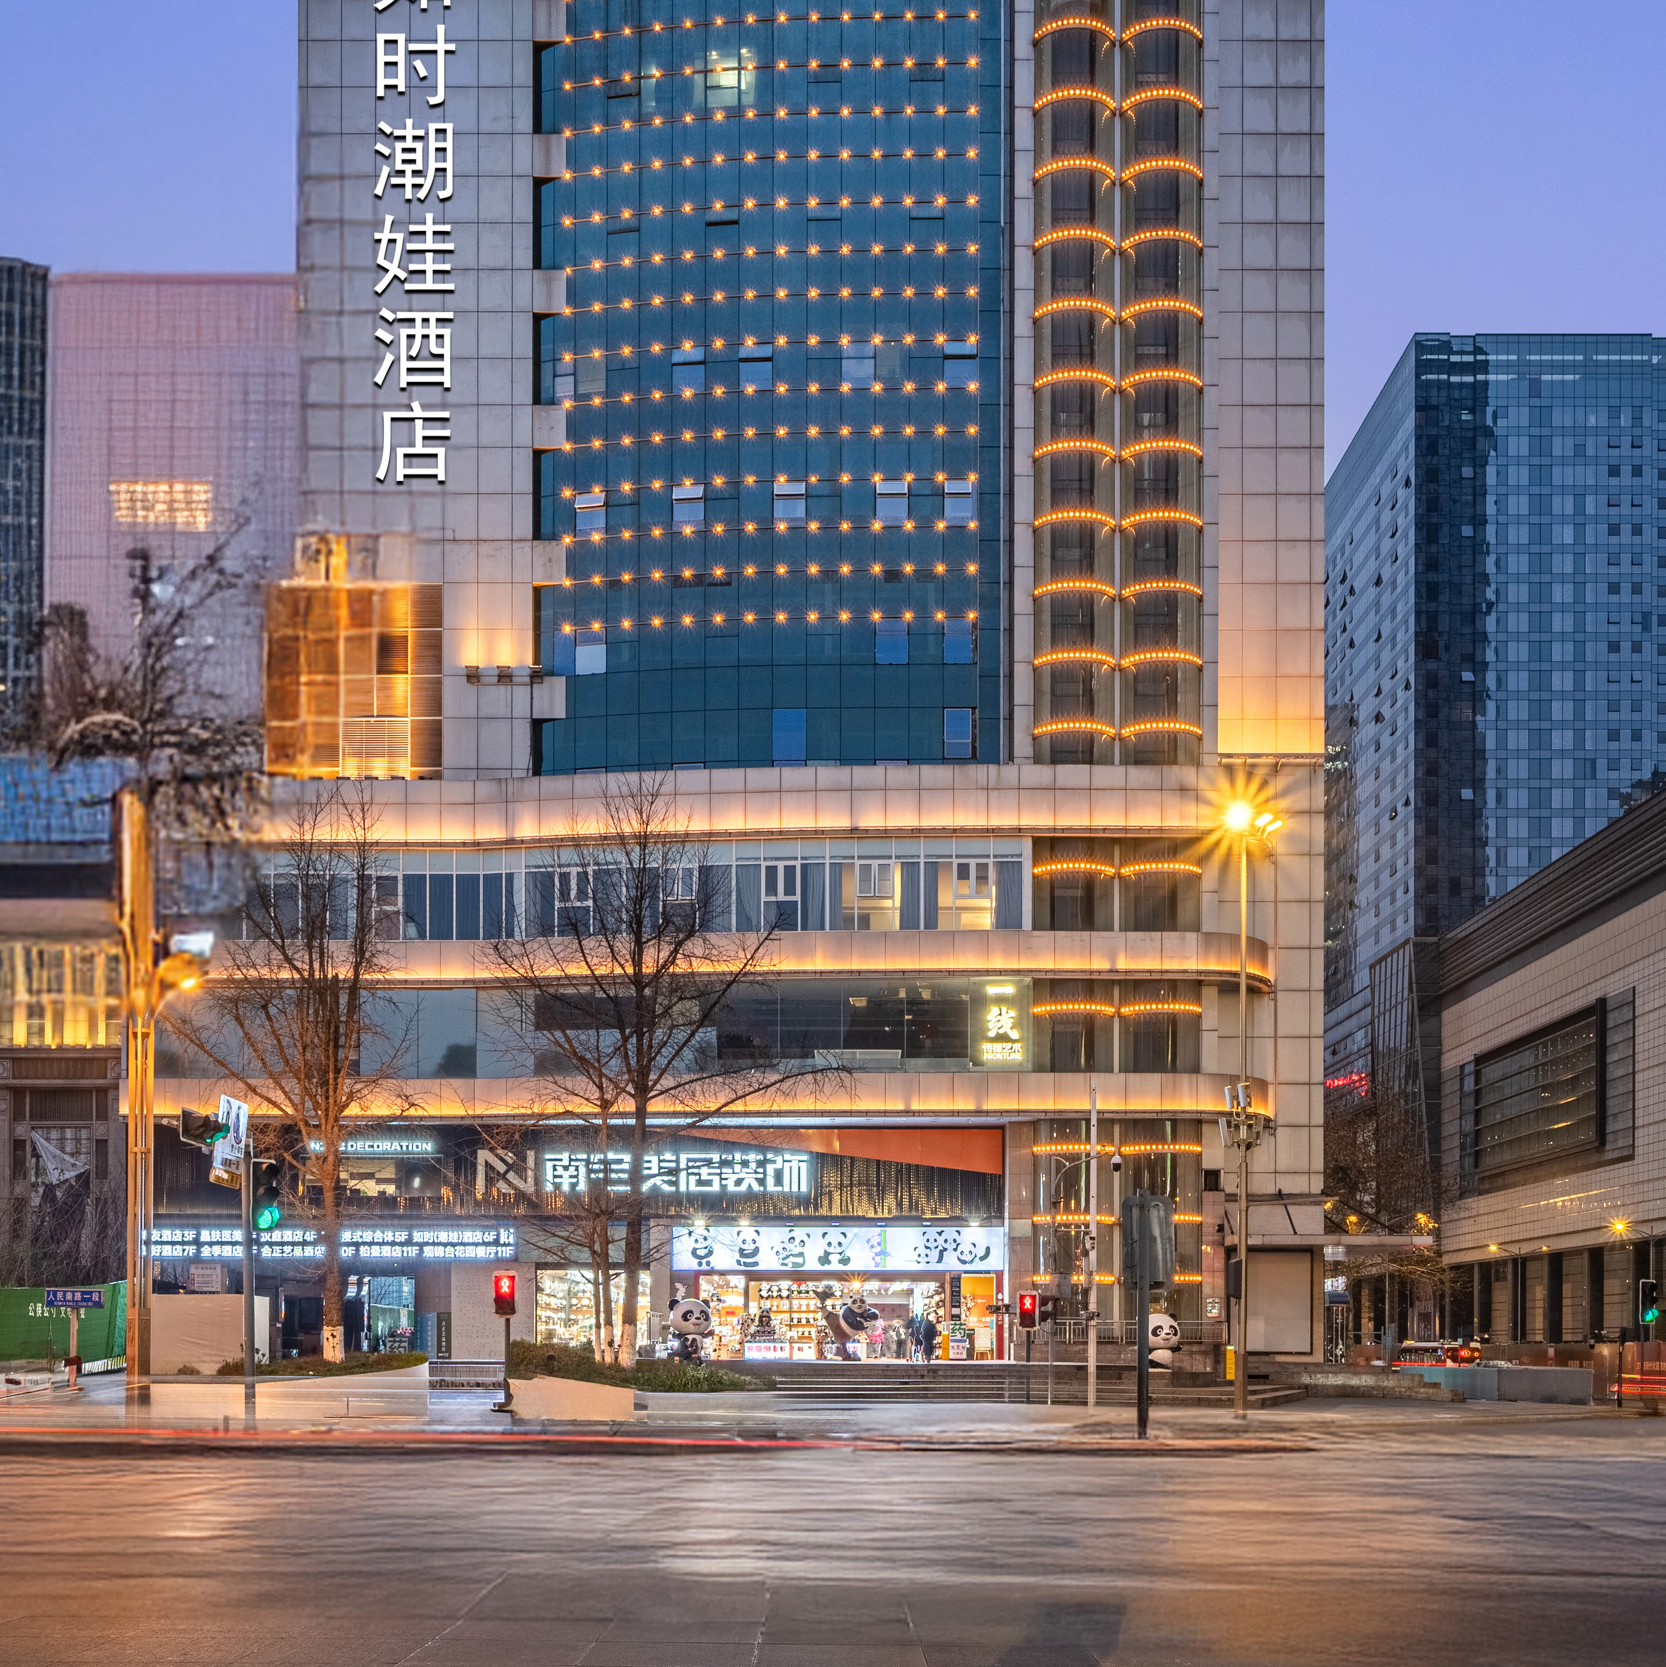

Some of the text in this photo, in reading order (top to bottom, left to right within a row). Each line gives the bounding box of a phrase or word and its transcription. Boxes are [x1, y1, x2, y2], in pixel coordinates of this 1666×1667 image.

[982, 1042, 1022, 1053] 传媒艺术
[983, 1052, 1022, 1060] FRONTLINE
[348, 1142, 432, 1151] DECORATION
[47, 1291, 100, 1302] 人民南路一段
[950, 1322, 966, 1338] 药
